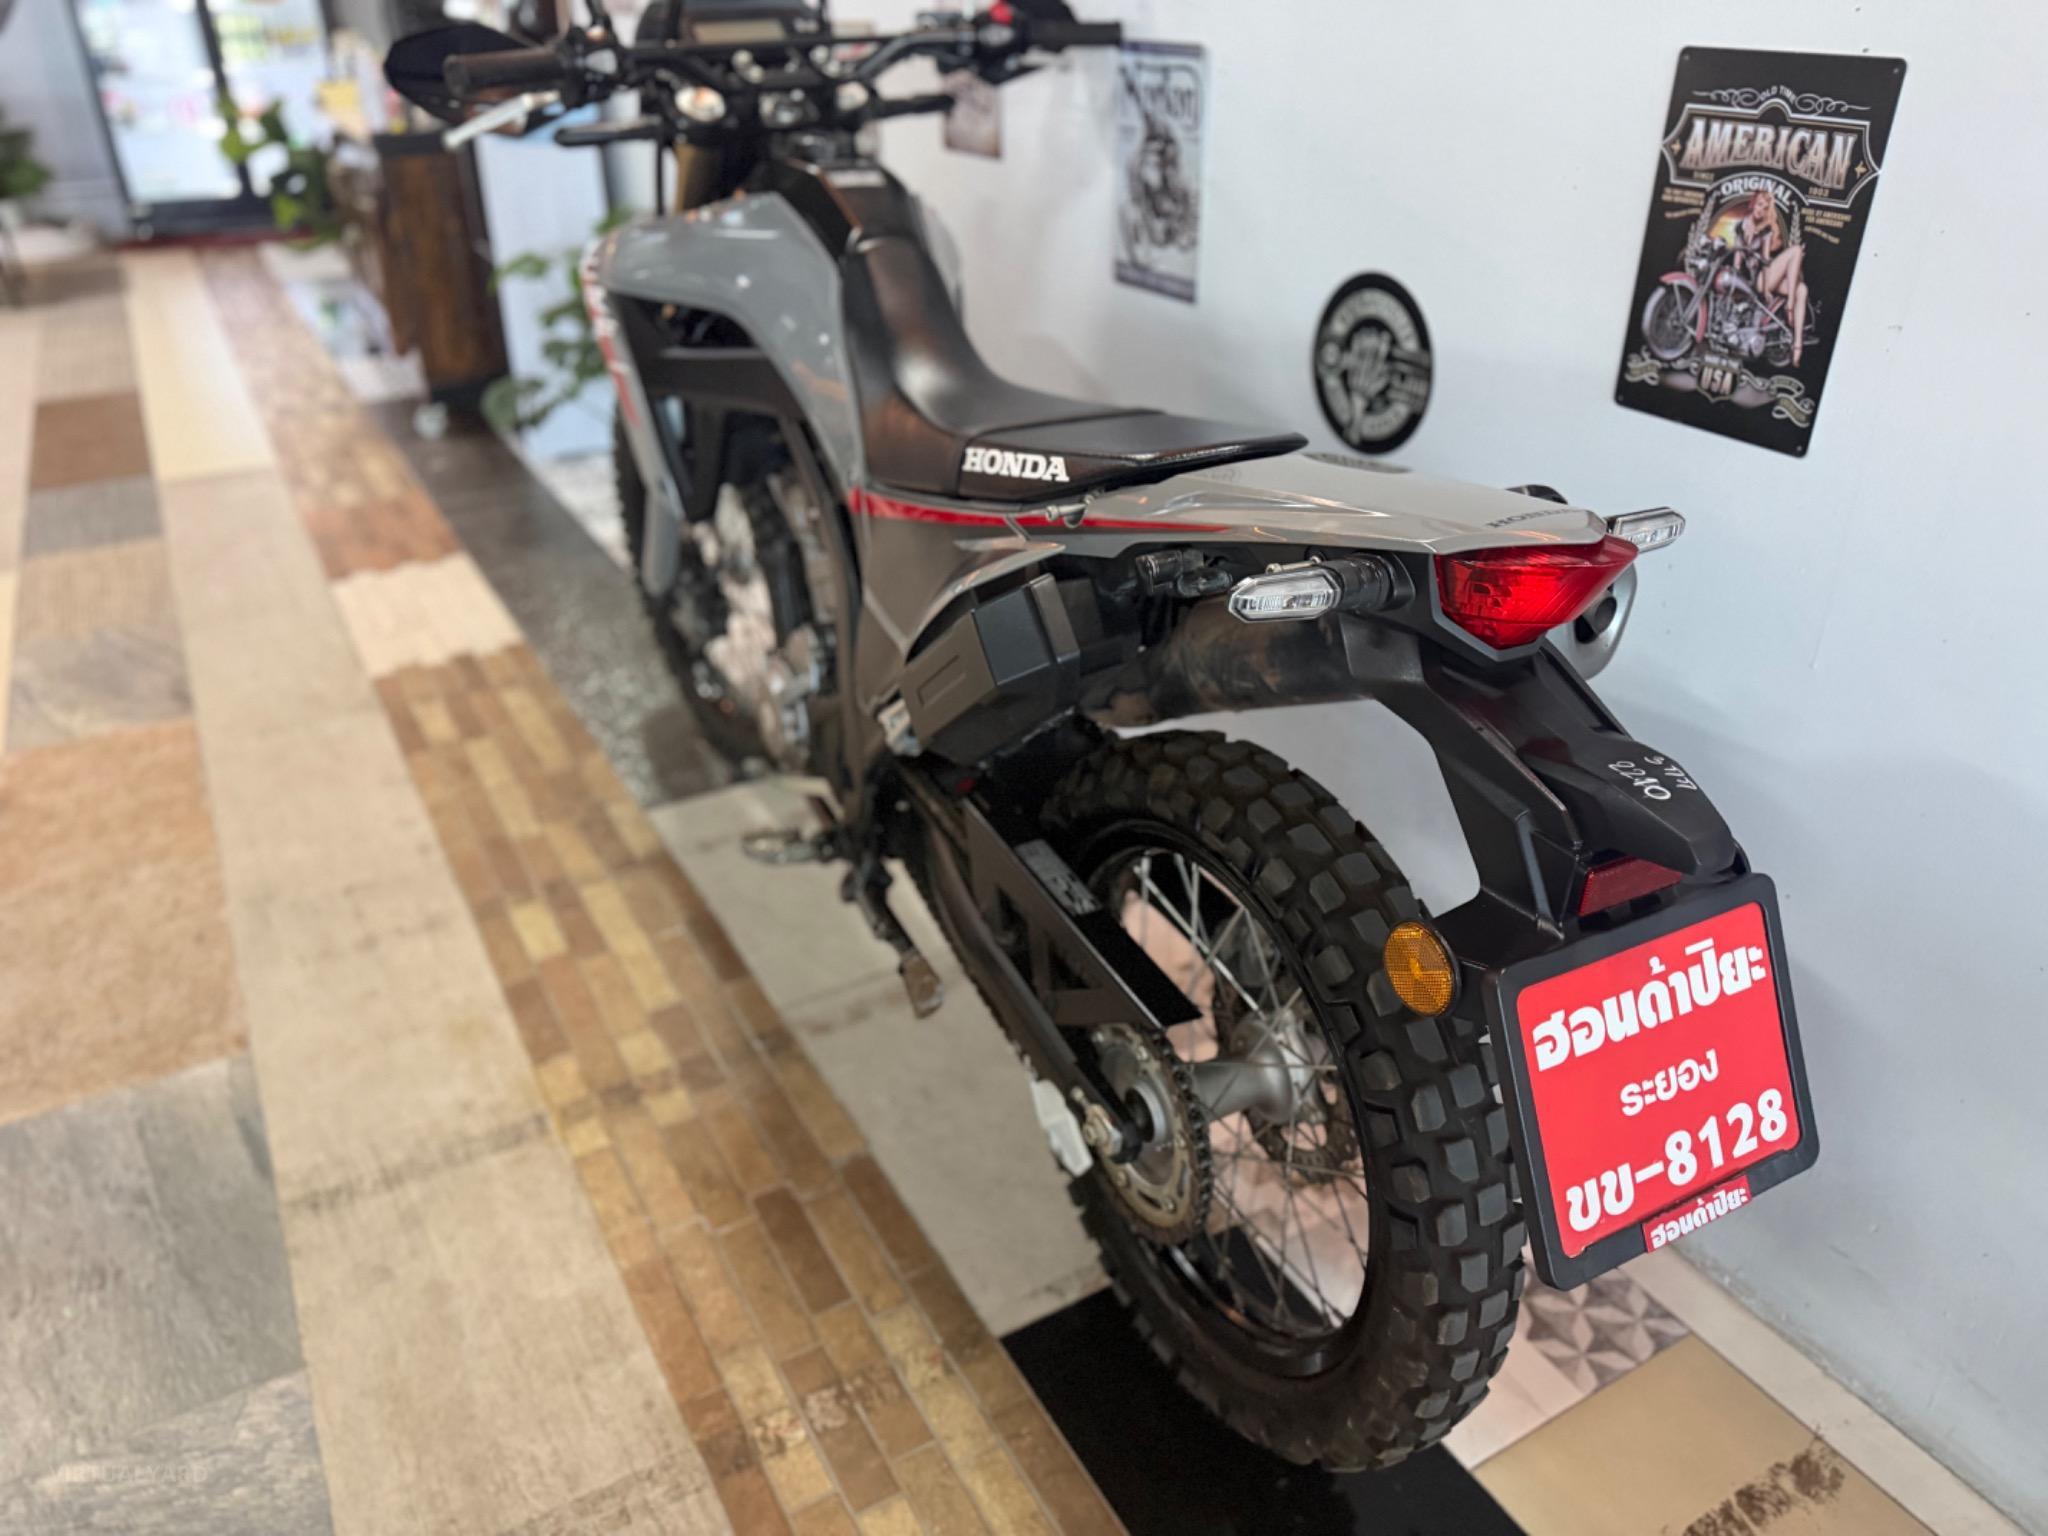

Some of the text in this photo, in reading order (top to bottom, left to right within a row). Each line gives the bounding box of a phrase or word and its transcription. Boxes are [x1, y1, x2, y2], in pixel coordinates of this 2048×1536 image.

[1678, 116, 1858, 190] AMERICAN
[1720, 175, 1792, 207] ORIGINAL
[1701, 365, 1733, 395] USA
[961, 447, 1071, 482] HONDA
[1532, 937, 1767, 1072] ฮอนด้าปิยะ
[1619, 1048, 1719, 1117] ระยอง
[1565, 1087, 1788, 1232] ขข-8128
